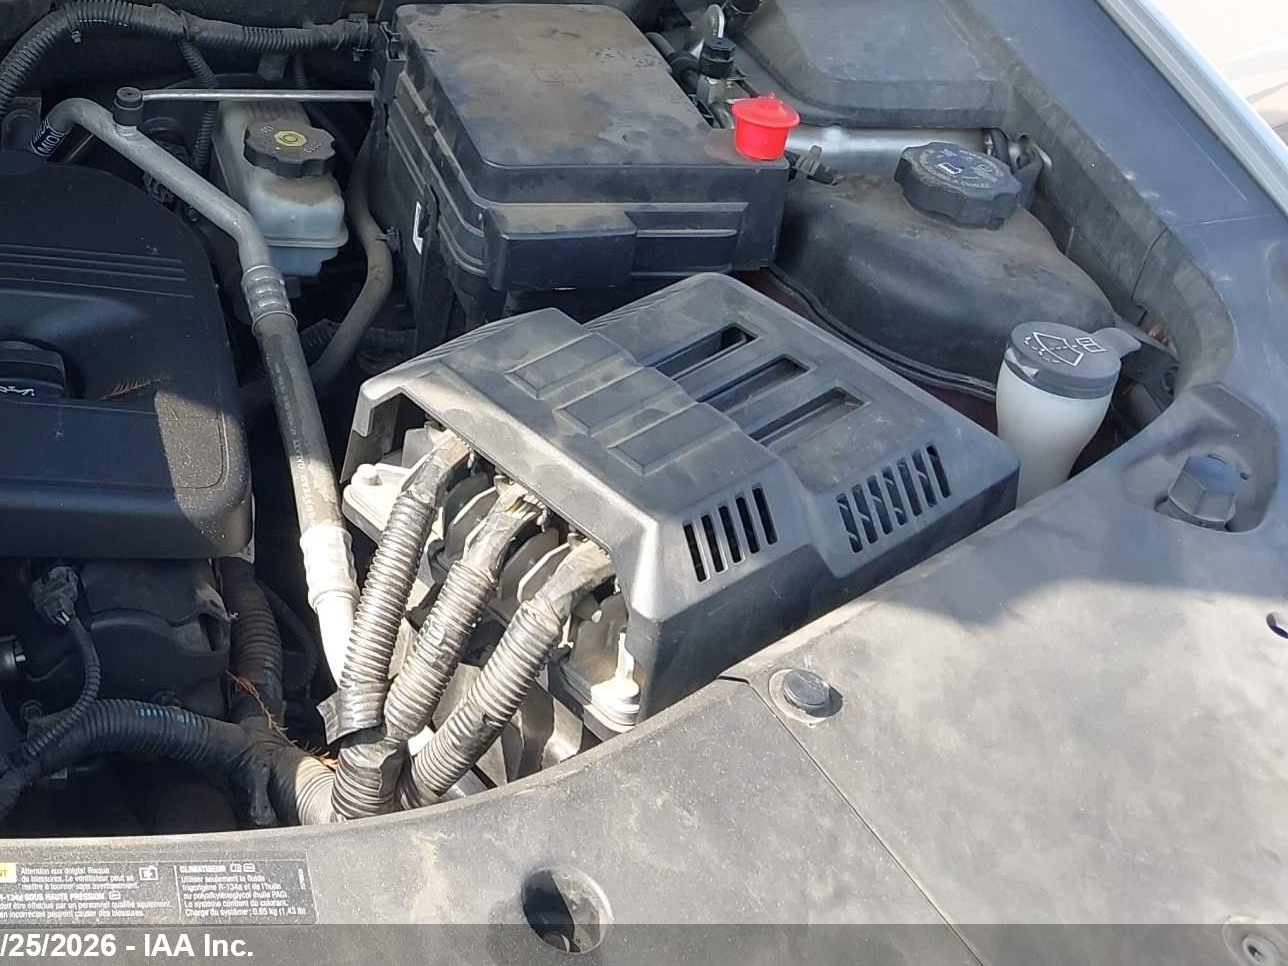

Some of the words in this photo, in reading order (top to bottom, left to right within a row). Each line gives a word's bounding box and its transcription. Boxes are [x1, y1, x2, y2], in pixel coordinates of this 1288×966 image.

[21, 867, 50, 875] Attention
[46, 893, 68, 901] HAUTE
[70, 893, 104, 901] PRESSION
